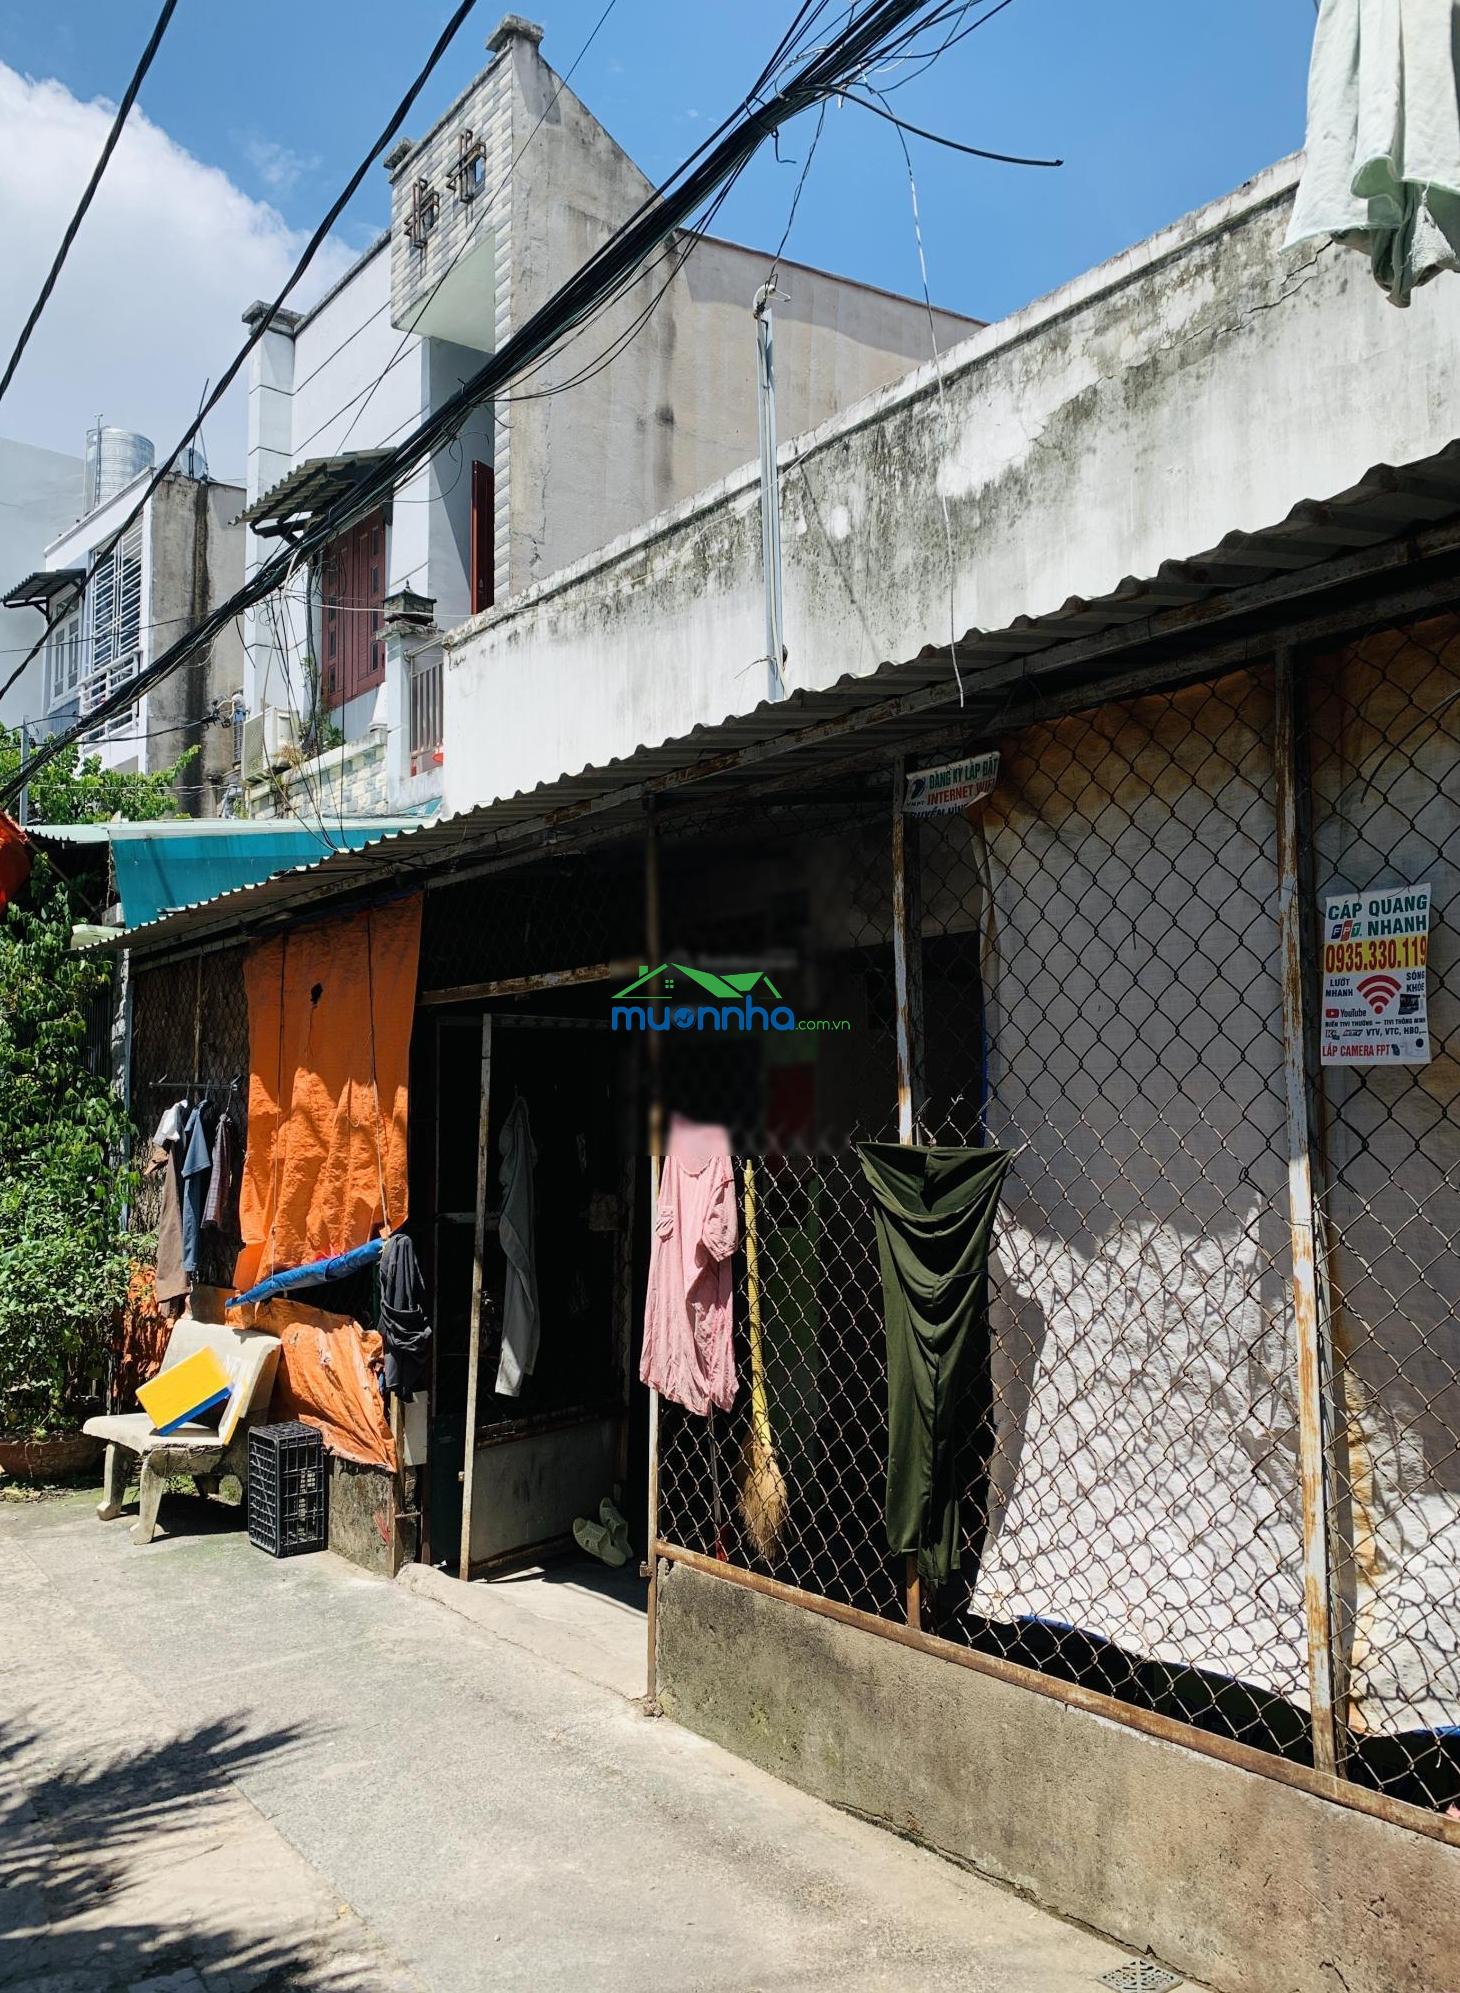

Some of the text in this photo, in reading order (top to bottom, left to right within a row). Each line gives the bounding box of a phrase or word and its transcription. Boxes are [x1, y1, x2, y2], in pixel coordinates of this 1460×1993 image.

[927, 784, 974, 806] INTERNET
[1328, 894, 1428, 920] CÁP QUANG
[1331, 914, 1427, 941] FPT NHANH
[1325, 935, 1427, 973] 0935.330.119
[1325, 988, 1353, 997] NHANH
[1340, 1008, 1367, 1018] YouTube
[1340, 1045, 1375, 1057] CAMERA
[1376, 1044, 1391, 1056] FPT
